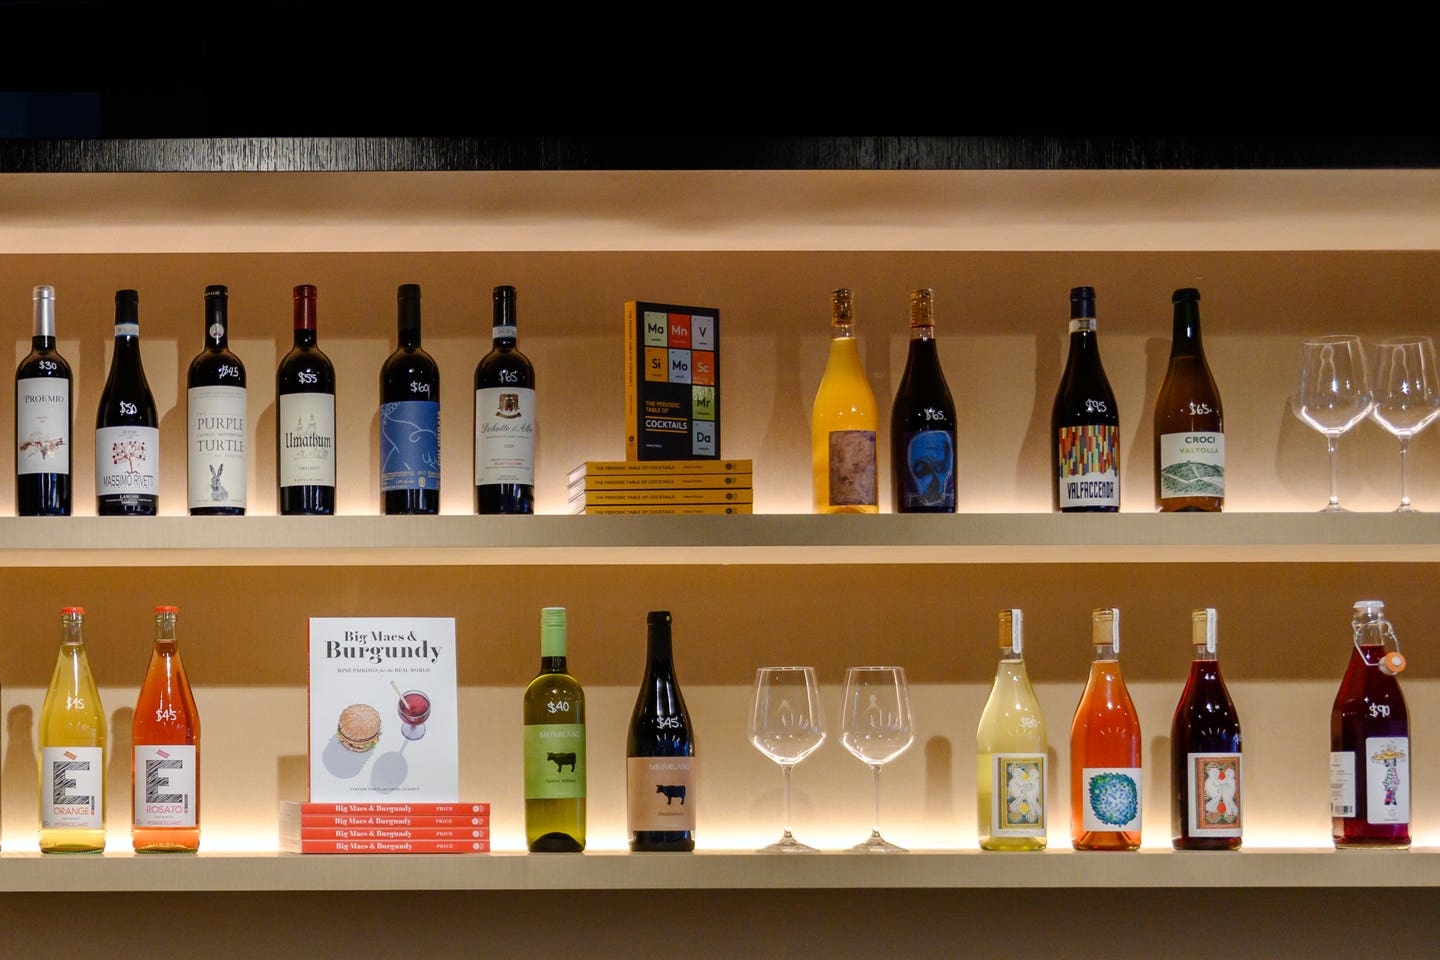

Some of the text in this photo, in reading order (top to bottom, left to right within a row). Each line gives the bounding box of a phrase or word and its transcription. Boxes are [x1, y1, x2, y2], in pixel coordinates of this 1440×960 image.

[648, 323, 664, 334] Ma
[671, 325, 688, 336] Mn
[698, 327, 707, 338] V
[39, 360, 57, 370] $30
[652, 358, 661, 369] Si
[672, 360, 688, 371] Mo
[697, 362, 709, 373] Sc
[24, 395, 64, 403] PROEMIO
[696, 397, 711, 408] Mr
[197, 417, 244, 430] PURPLE
[645, 419, 688, 430] COCKTAILS
[285, 432, 331, 449] Umathum
[697, 432, 711, 443] Da
[1185, 436, 1216, 444] CROCI
[196, 440, 244, 452] TURTLE
[345, 630, 417, 644] Big Macs &
[326, 640, 442, 664] Burgundy
[547, 701, 570, 714] $40
[155, 709, 177, 722] $45
[53, 806, 89, 816] ORANGE
[146, 805, 183, 814] ROSATO
[335, 830, 348, 838] Big
[376, 830, 412, 838] Burgundy
